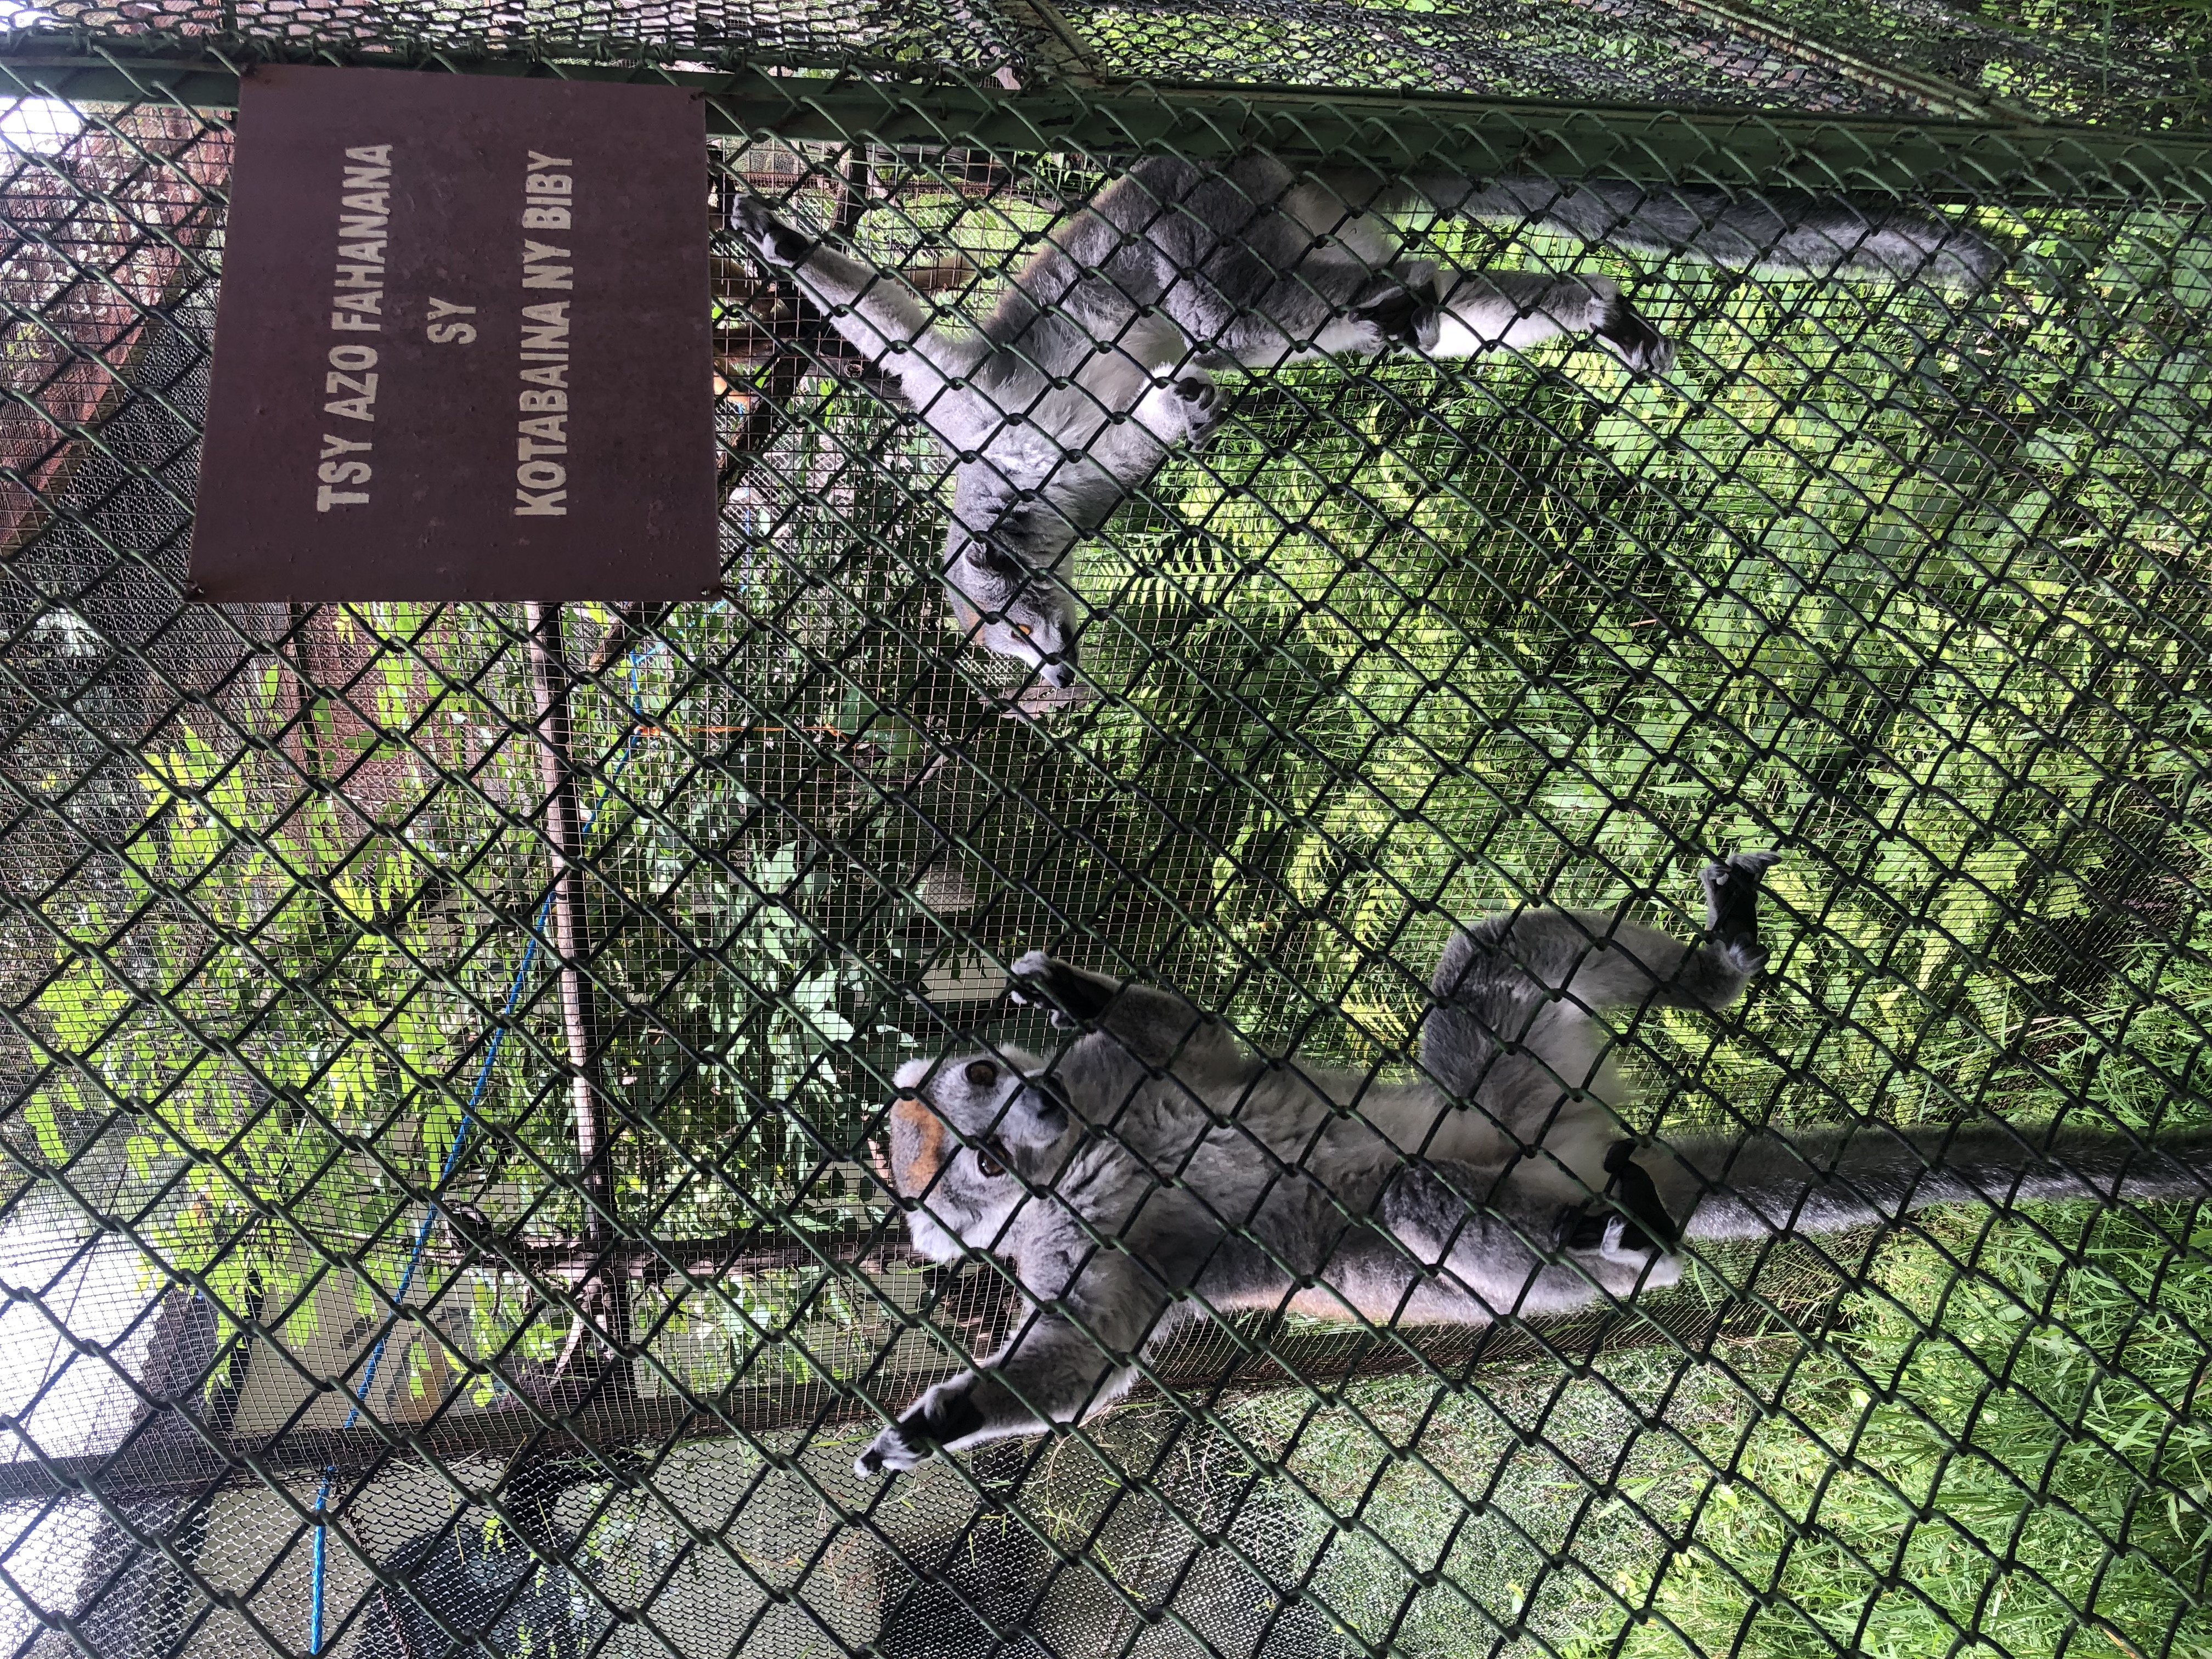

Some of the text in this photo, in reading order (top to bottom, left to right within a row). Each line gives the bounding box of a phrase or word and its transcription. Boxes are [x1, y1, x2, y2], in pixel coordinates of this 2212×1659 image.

[316, 144, 393, 513] TSY AZO FAHANANA
[426, 296, 477, 345] SY
[514, 149, 574, 516] KOTABAINA NY BIBY
